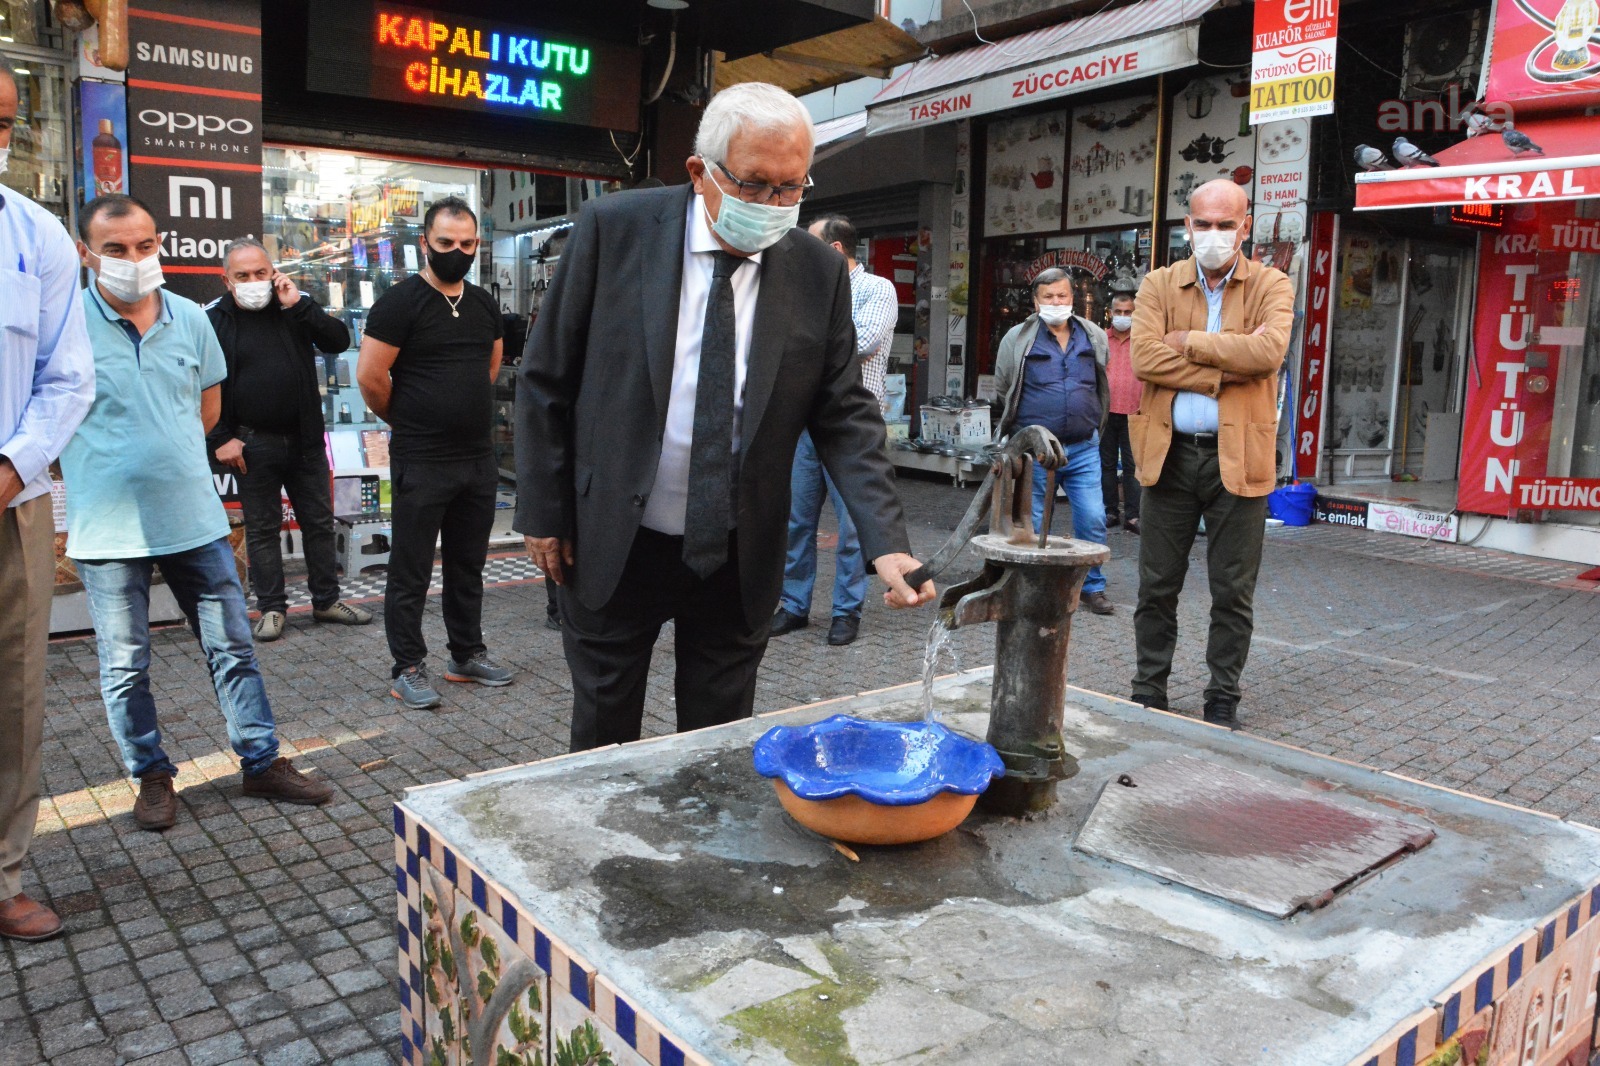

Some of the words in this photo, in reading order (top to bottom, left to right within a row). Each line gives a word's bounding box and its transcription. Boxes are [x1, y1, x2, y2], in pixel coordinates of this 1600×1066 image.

[378, 13, 500, 61] KAPALI
[508, 36, 590, 75] KUTU
[1255, 25, 1302, 49] KUAFÖR
[136, 42, 253, 74] SAMSUNG
[1254, 63, 1297, 80] STÜDYO
[1298, 52, 1333, 73] elit
[405, 57, 562, 110] CİHAZLAR
[1012, 51, 1139, 99] ZÜCCACİYE
[909, 93, 972, 121] TAŞKIN
[1253, 75, 1332, 109] TATTOO
[144, 137, 250, 154] SMARTPHONE
[1260, 171, 1302, 185] ERYAZICI
[1464, 170, 1585, 200] KRAL
[1263, 190, 1272, 203] İŞ
[1274, 189, 1298, 200] HANI
[1300, 249, 1329, 456] KUAFÖR
[1484, 264, 1538, 494] TÜTÜN
[1328, 512, 1366, 527] emlak
